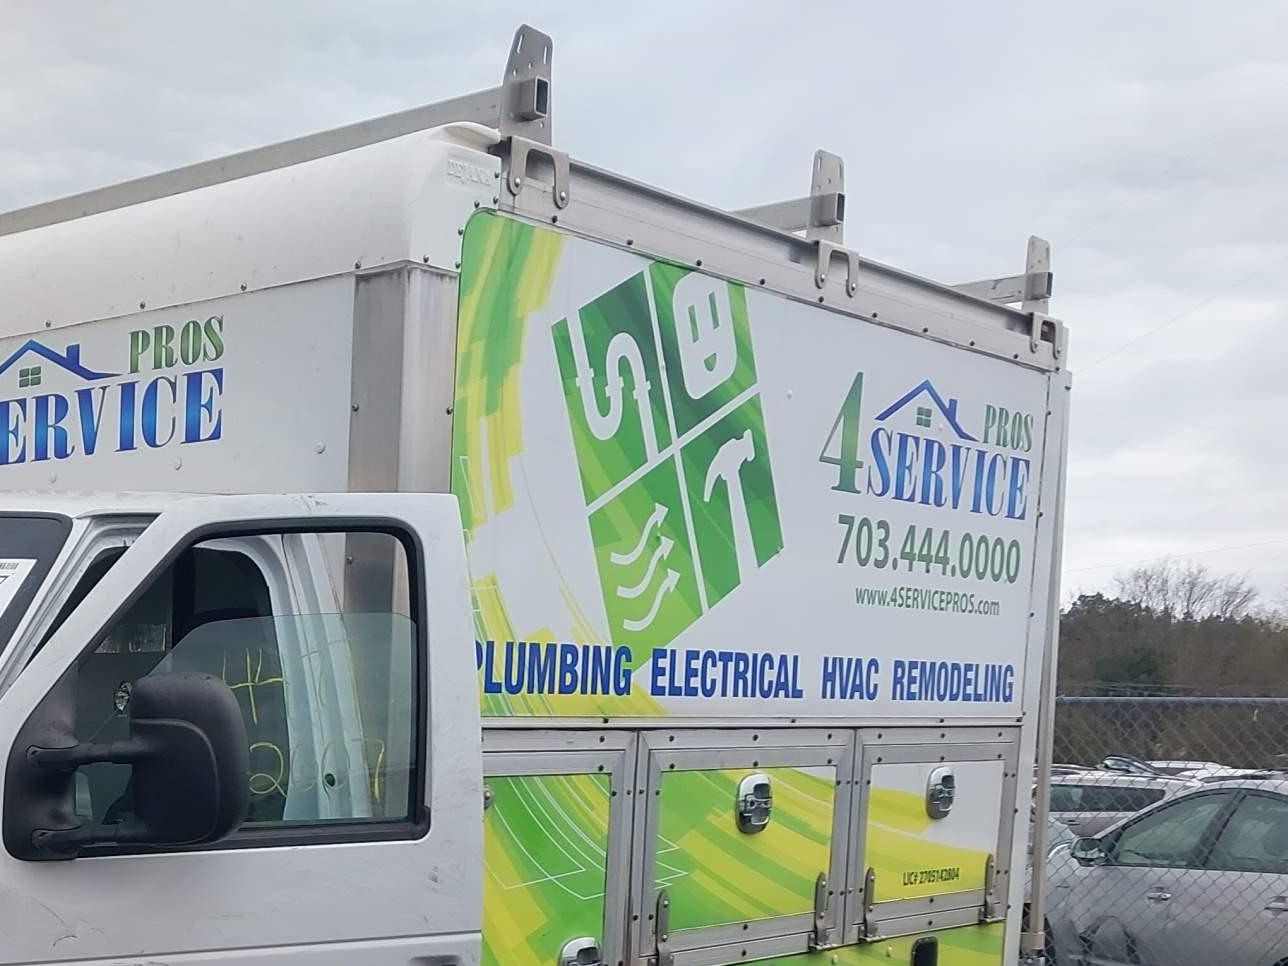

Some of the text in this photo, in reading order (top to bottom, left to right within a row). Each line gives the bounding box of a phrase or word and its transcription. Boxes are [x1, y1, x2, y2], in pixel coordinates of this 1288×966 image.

[127, 314, 224, 374] PROS
[818, 371, 1031, 521] 4 SERVICE
[982, 404, 1034, 452] PROS
[837, 513, 1021, 584] 703.444.0000
[855, 586, 1001, 616] www.4SERVICEPROS.com
[650, 647, 804, 699] ELECTRICAL
[821, 656, 880, 701] HVAC
[892, 660, 1015, 703] REMODELING
